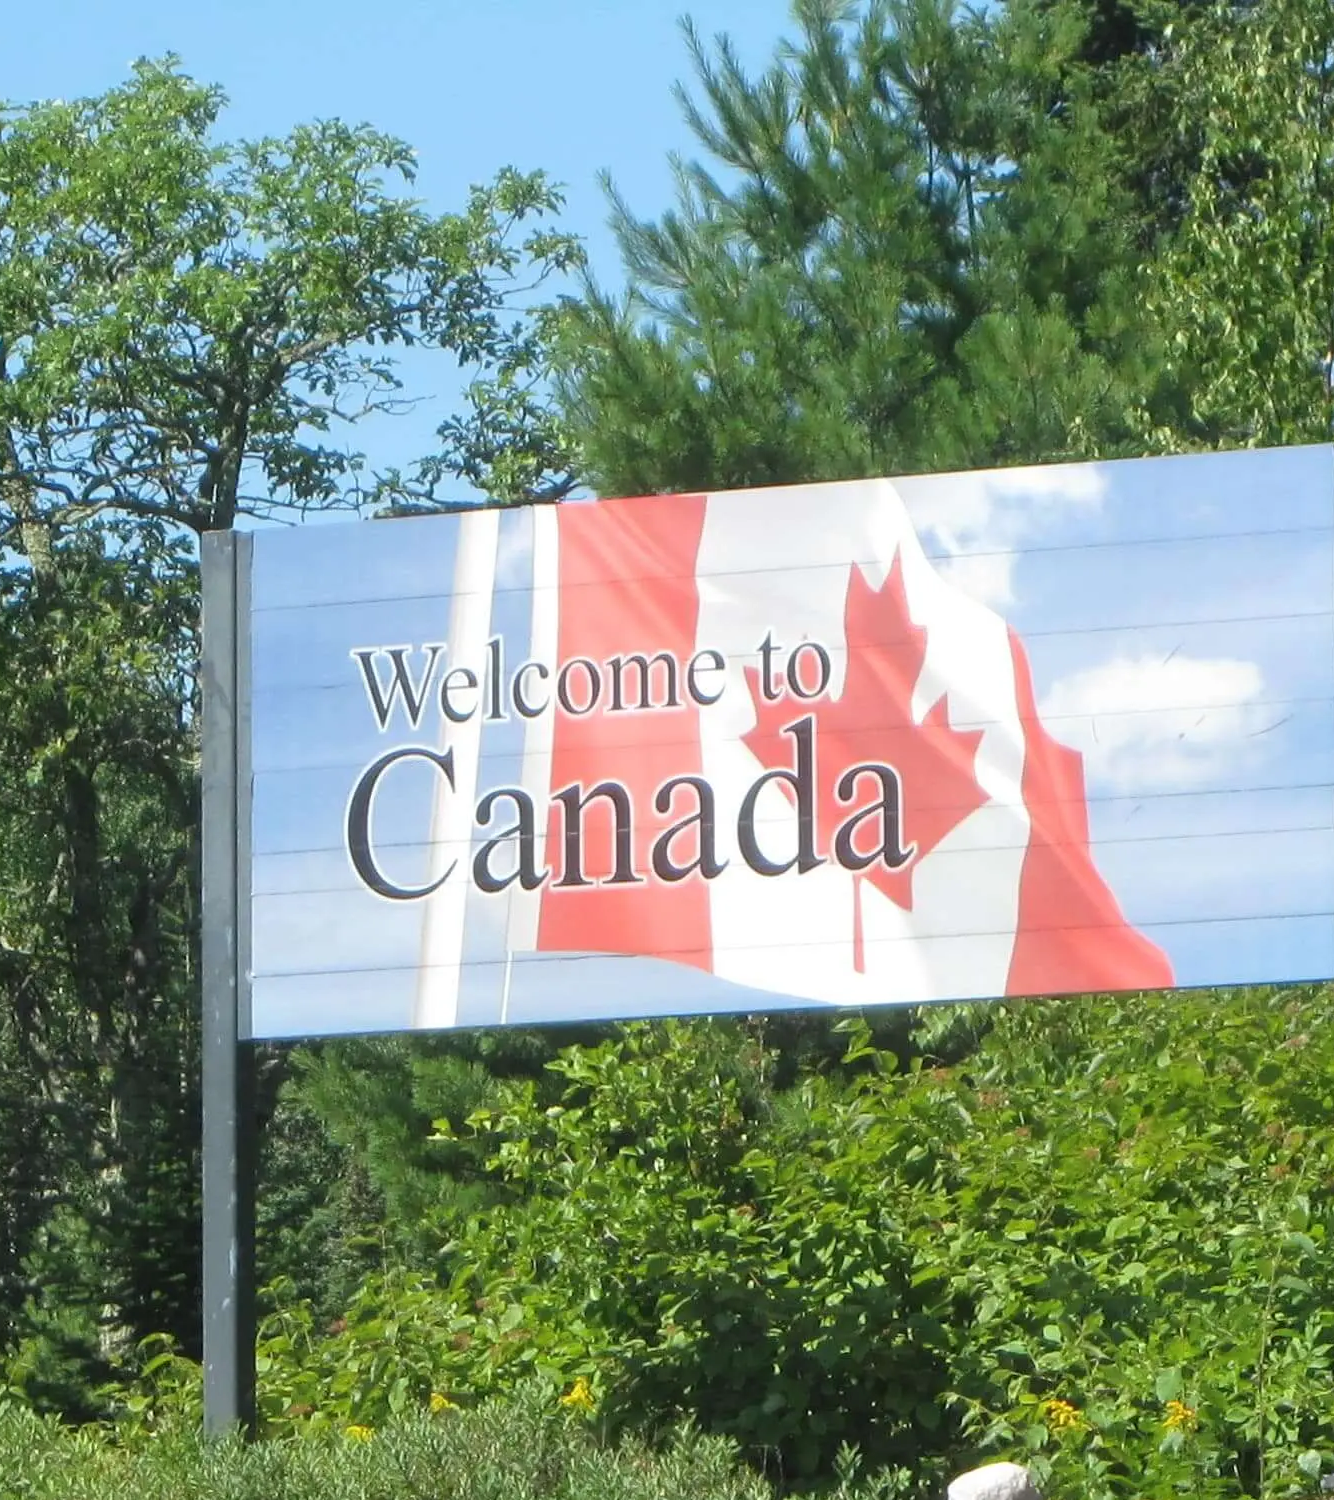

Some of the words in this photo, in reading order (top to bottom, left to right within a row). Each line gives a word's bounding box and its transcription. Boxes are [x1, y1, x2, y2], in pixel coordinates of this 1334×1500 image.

[353, 637, 727, 730] Welcome
[757, 628, 832, 701] to
[347, 715, 916, 900] Canada
